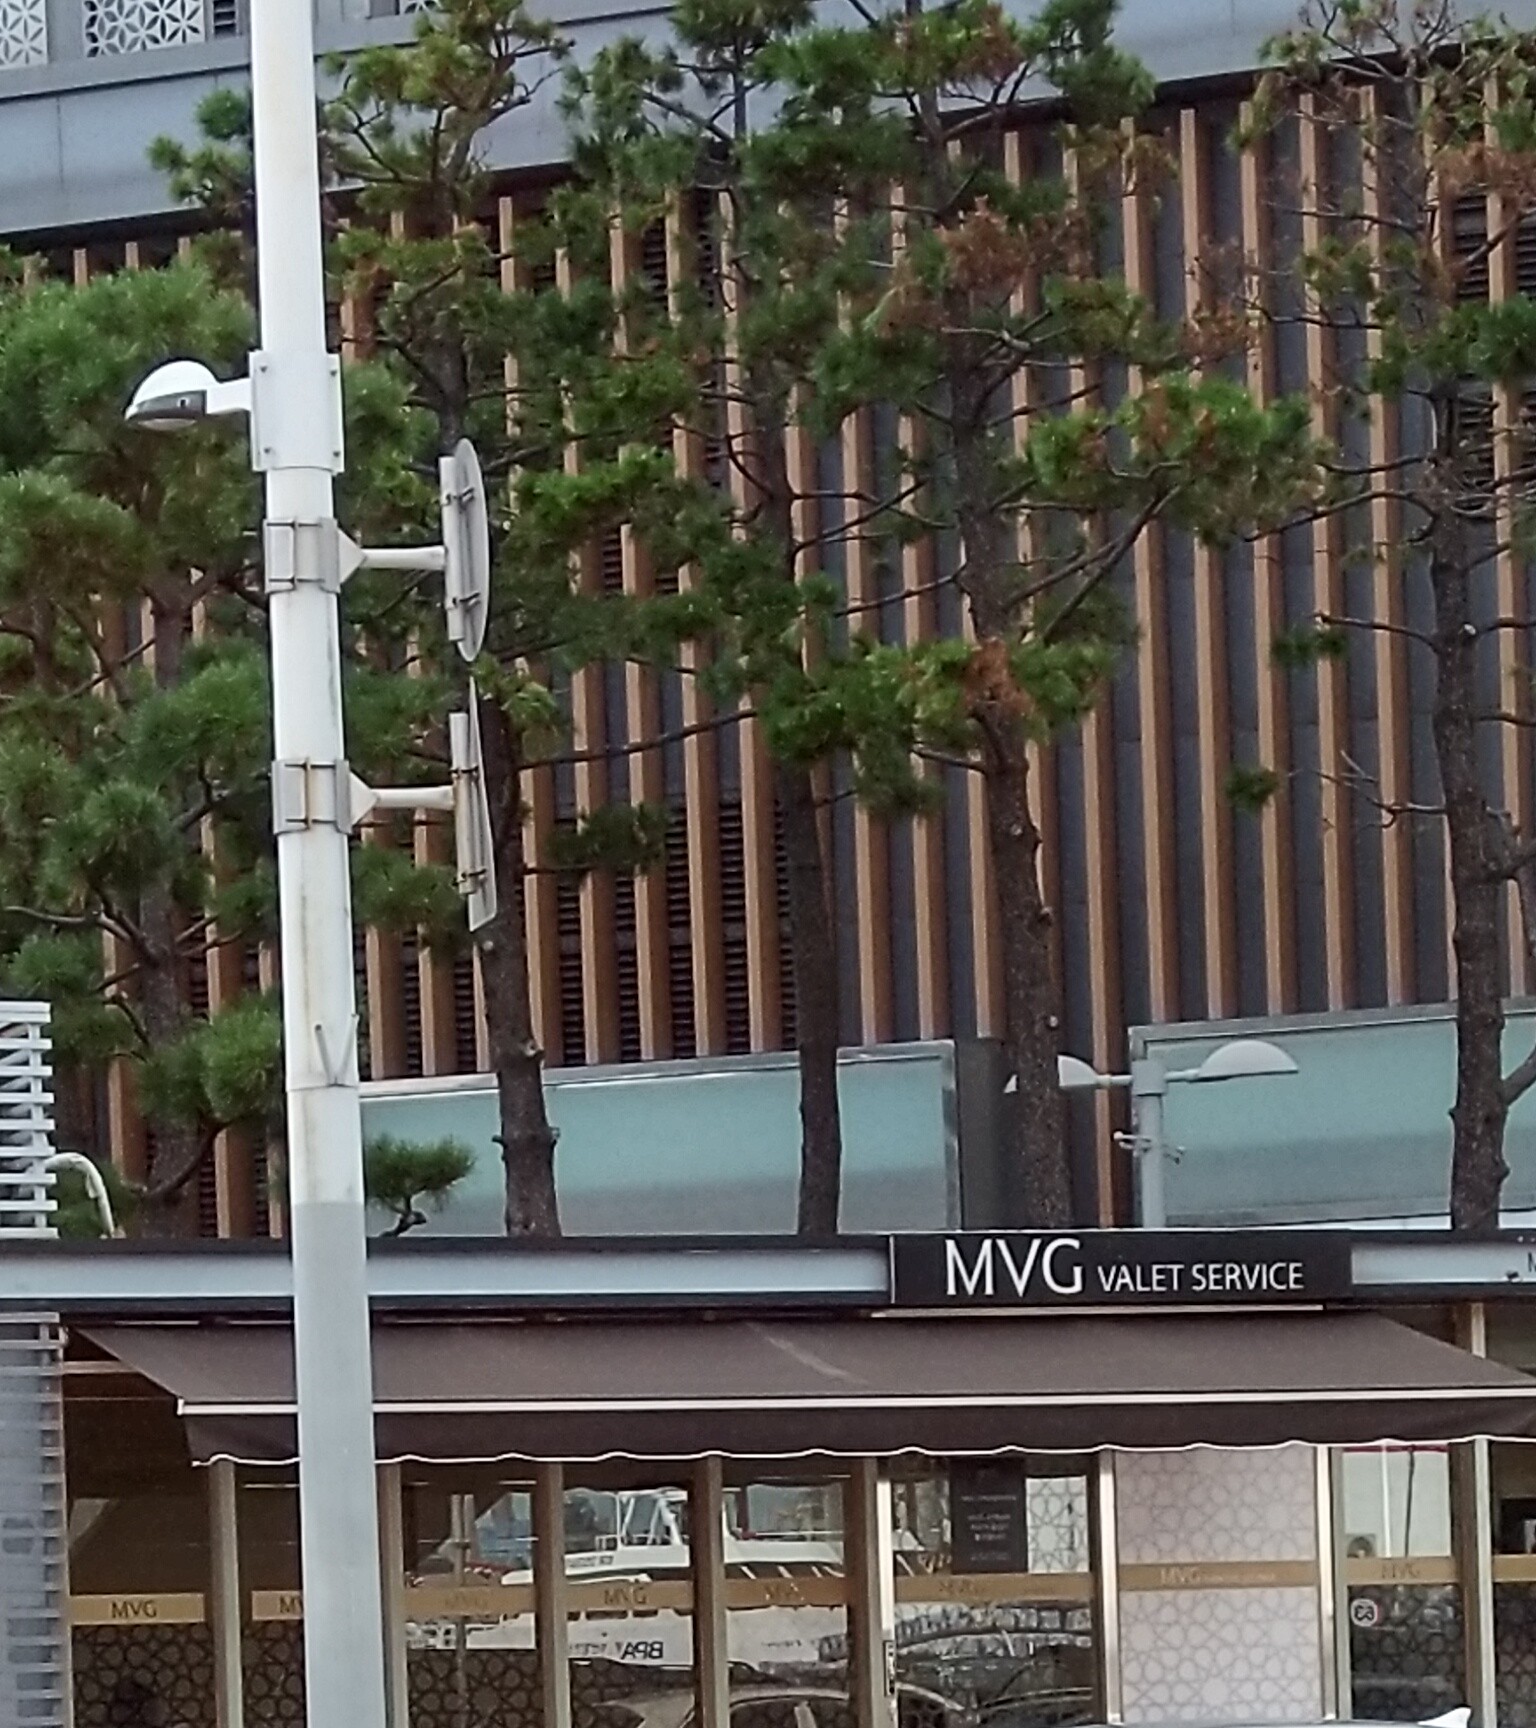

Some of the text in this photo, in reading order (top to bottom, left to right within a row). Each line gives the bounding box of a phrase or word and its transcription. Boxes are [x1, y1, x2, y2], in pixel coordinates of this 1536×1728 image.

[945, 1238, 1304, 1297] MVG VALET SERVICE
[110, 1600, 157, 1619] MVG
